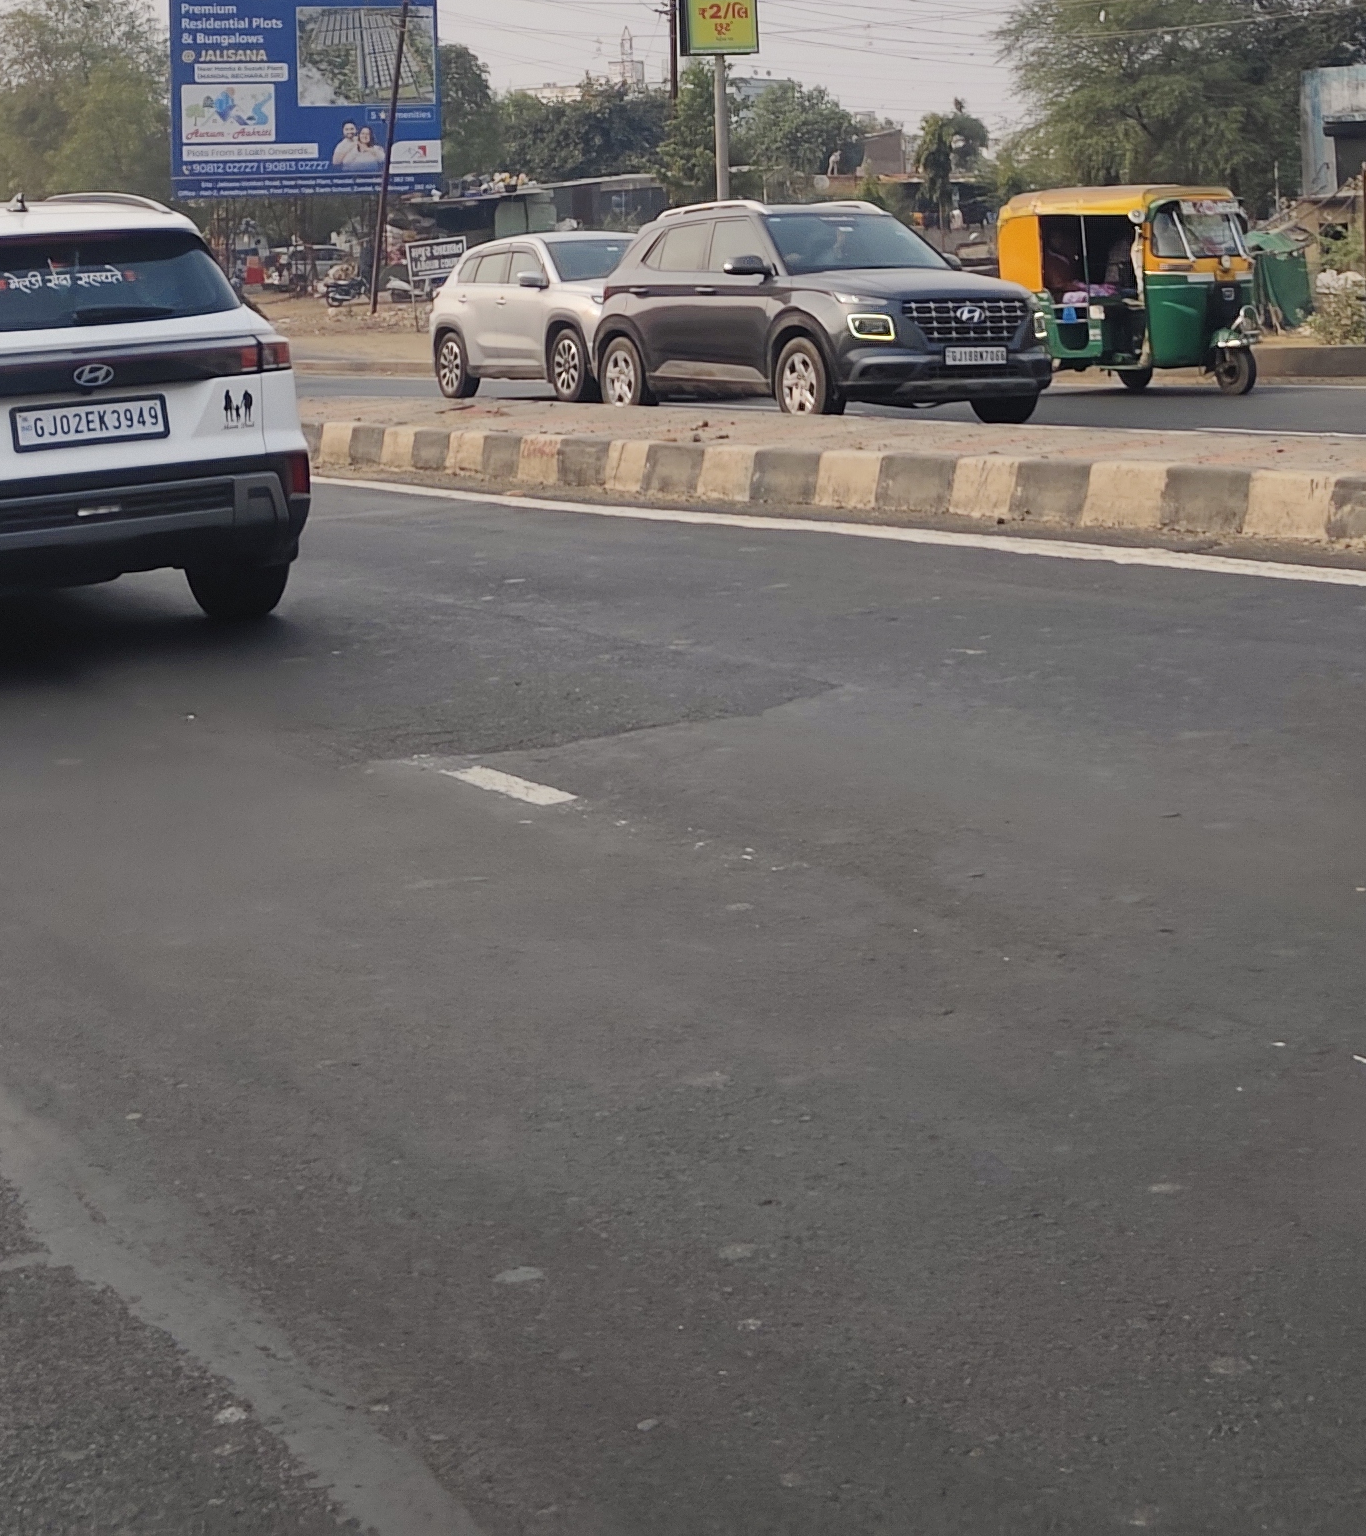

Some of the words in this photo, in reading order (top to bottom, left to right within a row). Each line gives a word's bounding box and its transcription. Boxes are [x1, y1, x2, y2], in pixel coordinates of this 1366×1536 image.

[181, 3, 237, 14] Premium
[181, 17, 248, 29] Residential
[252, 17, 283, 29] Plots
[181, 33, 193, 44] &
[196, 32, 264, 46] Bungalows
[181, 50, 195, 62] @
[199, 49, 268, 62] JALISANA
[395, 110, 431, 118] menities
[187, 149, 209, 157] Plots
[211, 149, 235, 157] From
[245, 148, 265, 156] Lakh
[193, 163, 223, 173] 90812
[226, 162, 257, 172] 02727
[265, 162, 295, 172] 90813
[298, 160, 329, 170] 02727
[34, 406, 159, 438] GJ02EK3949
